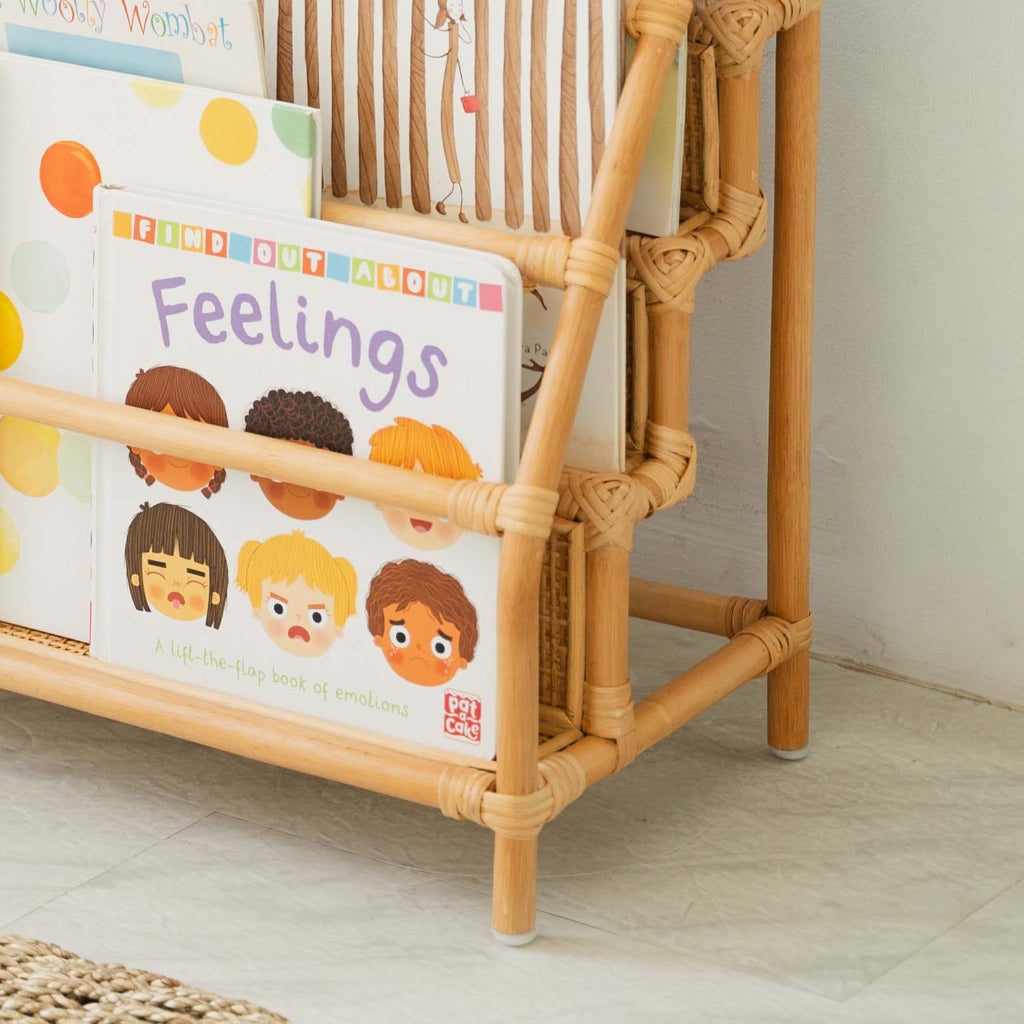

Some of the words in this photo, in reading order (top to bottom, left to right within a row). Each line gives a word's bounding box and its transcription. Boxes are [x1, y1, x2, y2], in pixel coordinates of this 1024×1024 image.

[139, 218, 224, 254] FIND
[257, 242, 323, 273] OUT
[355, 261, 474, 303] ABOUT
[152, 276, 448, 412] Feelings
[155, 638, 164, 653] A
[171, 639, 266, 686] lift-the-flap
[272, 666, 307, 692] book
[313, 682, 328, 702] of
[335, 687, 409, 718] emotions
[449, 695, 477, 719] pat
